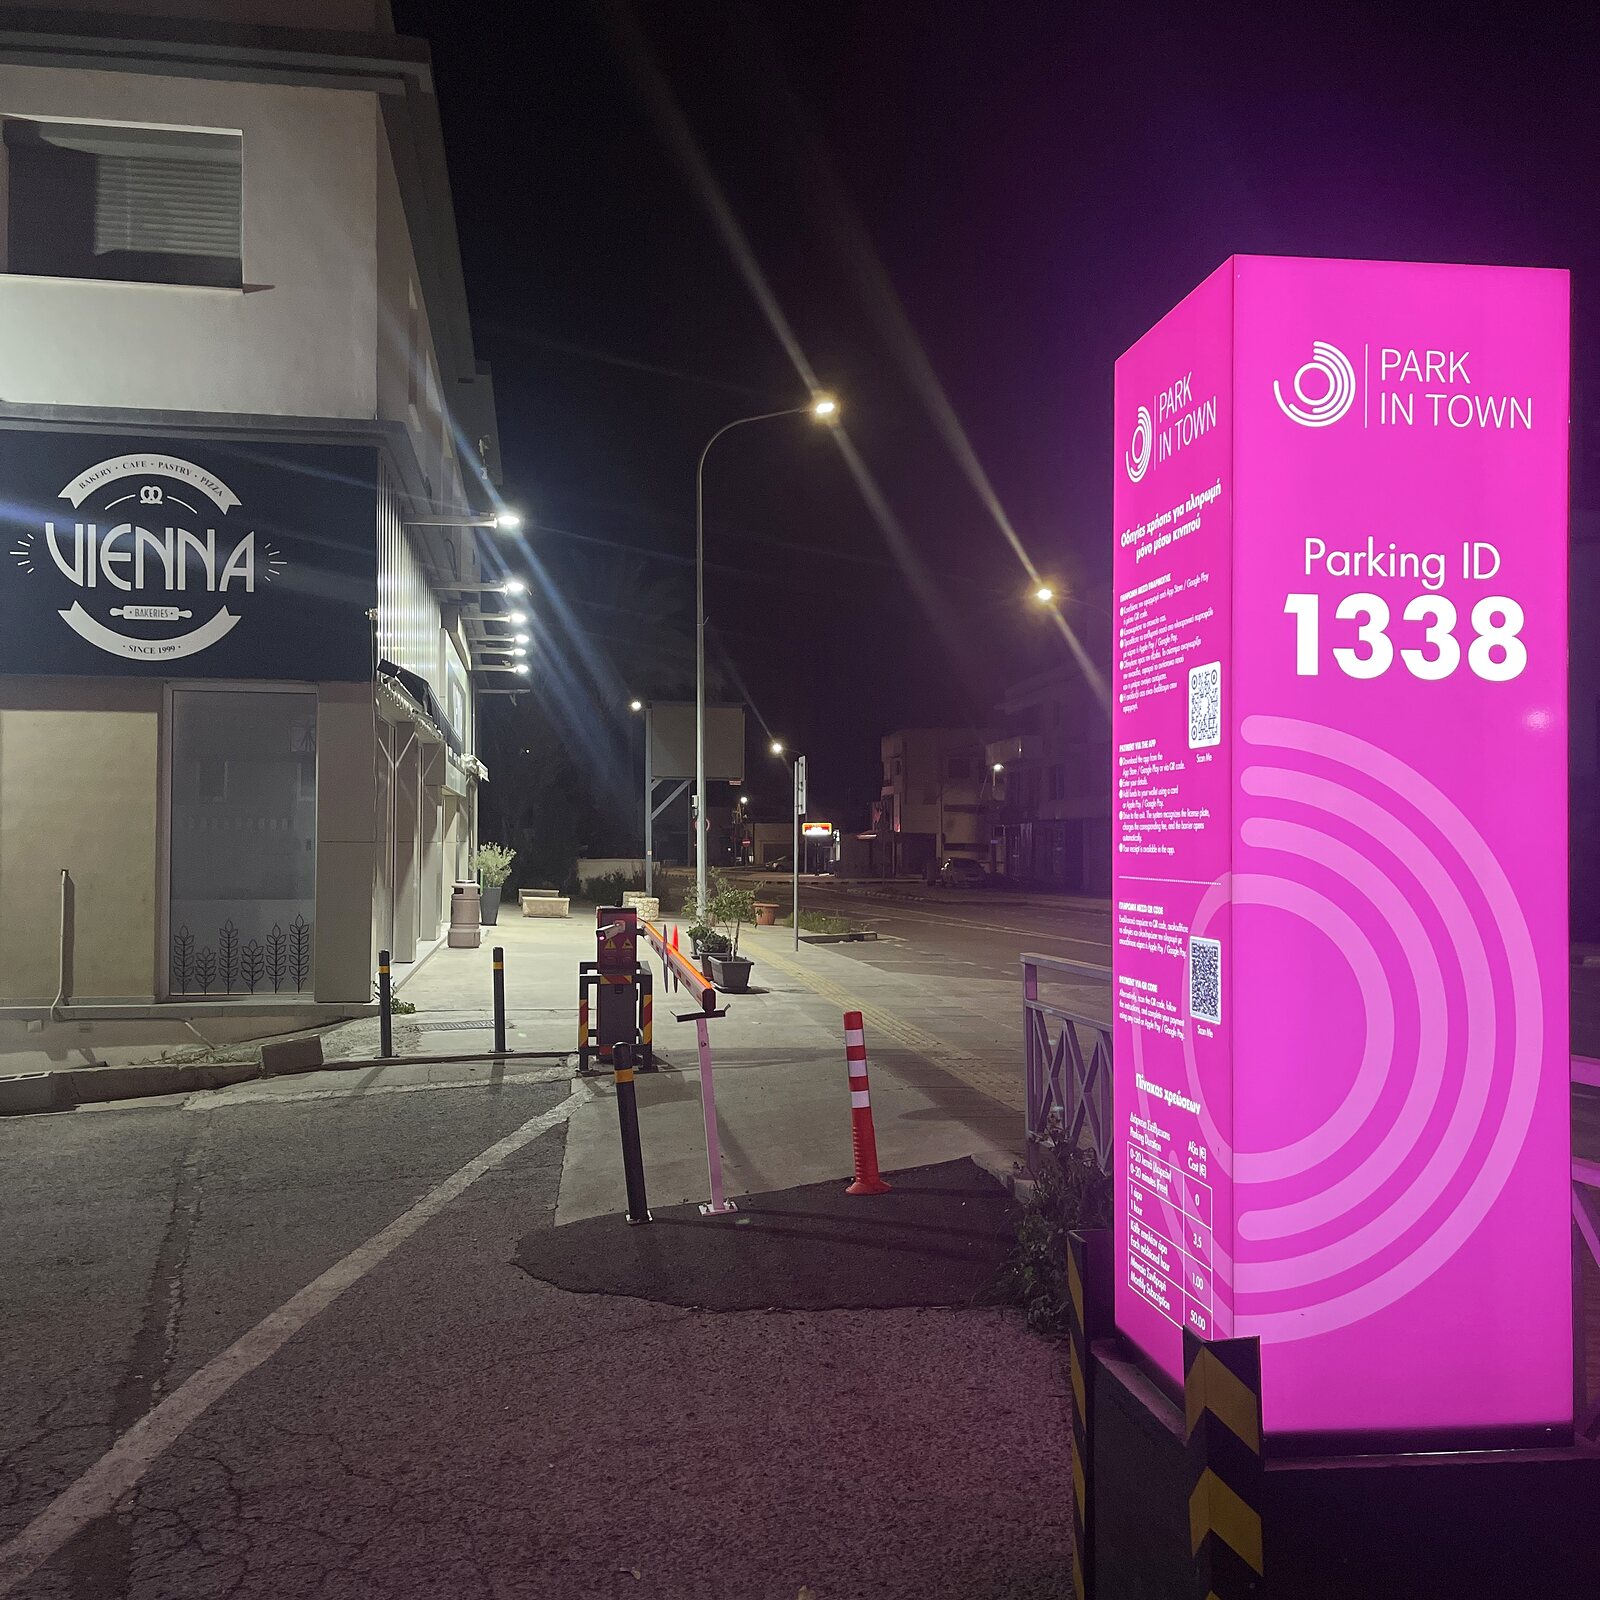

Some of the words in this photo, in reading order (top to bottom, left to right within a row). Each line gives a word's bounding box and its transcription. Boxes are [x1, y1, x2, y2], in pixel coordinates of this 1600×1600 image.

[1381, 348, 1470, 384] PARK
[1160, 371, 1192, 423] PARK
[1381, 392, 1413, 425] IN
[1425, 393, 1532, 429] TOWN
[1160, 428, 1171, 462] IN
[1175, 396, 1216, 450] TOWN
[78, 467, 112, 489] BAKERY
[122, 461, 147, 470] CAFE
[158, 462, 192, 476] PASTRY
[200, 477, 223, 497] PIZZA
[1121, 524, 1145, 547] Οδηγίες
[1147, 513, 1171, 536] χρήσης
[1173, 504, 1184, 523] για
[1186, 478, 1221, 509] πληρωμή
[45, 522, 254, 592] VIENNA
[1136, 542, 1152, 564] μόνο
[1154, 533, 1171, 555] μέσω
[1173, 513, 1200, 541] κινητού
[1305, 536, 1446, 590] Parking
[1463, 542, 1501, 579] ID
[134, 608, 168, 618] BAKERIES
[129, 645, 155, 654] SINCE
[158, 645, 176, 654] 1999
[1283, 592, 1527, 682] 1338
[1136, 1073, 1164, 1098] Πίνακας
[1164, 1089, 1201, 1115] χρεώσεων
[1195, 1194, 1200, 1206] 0
